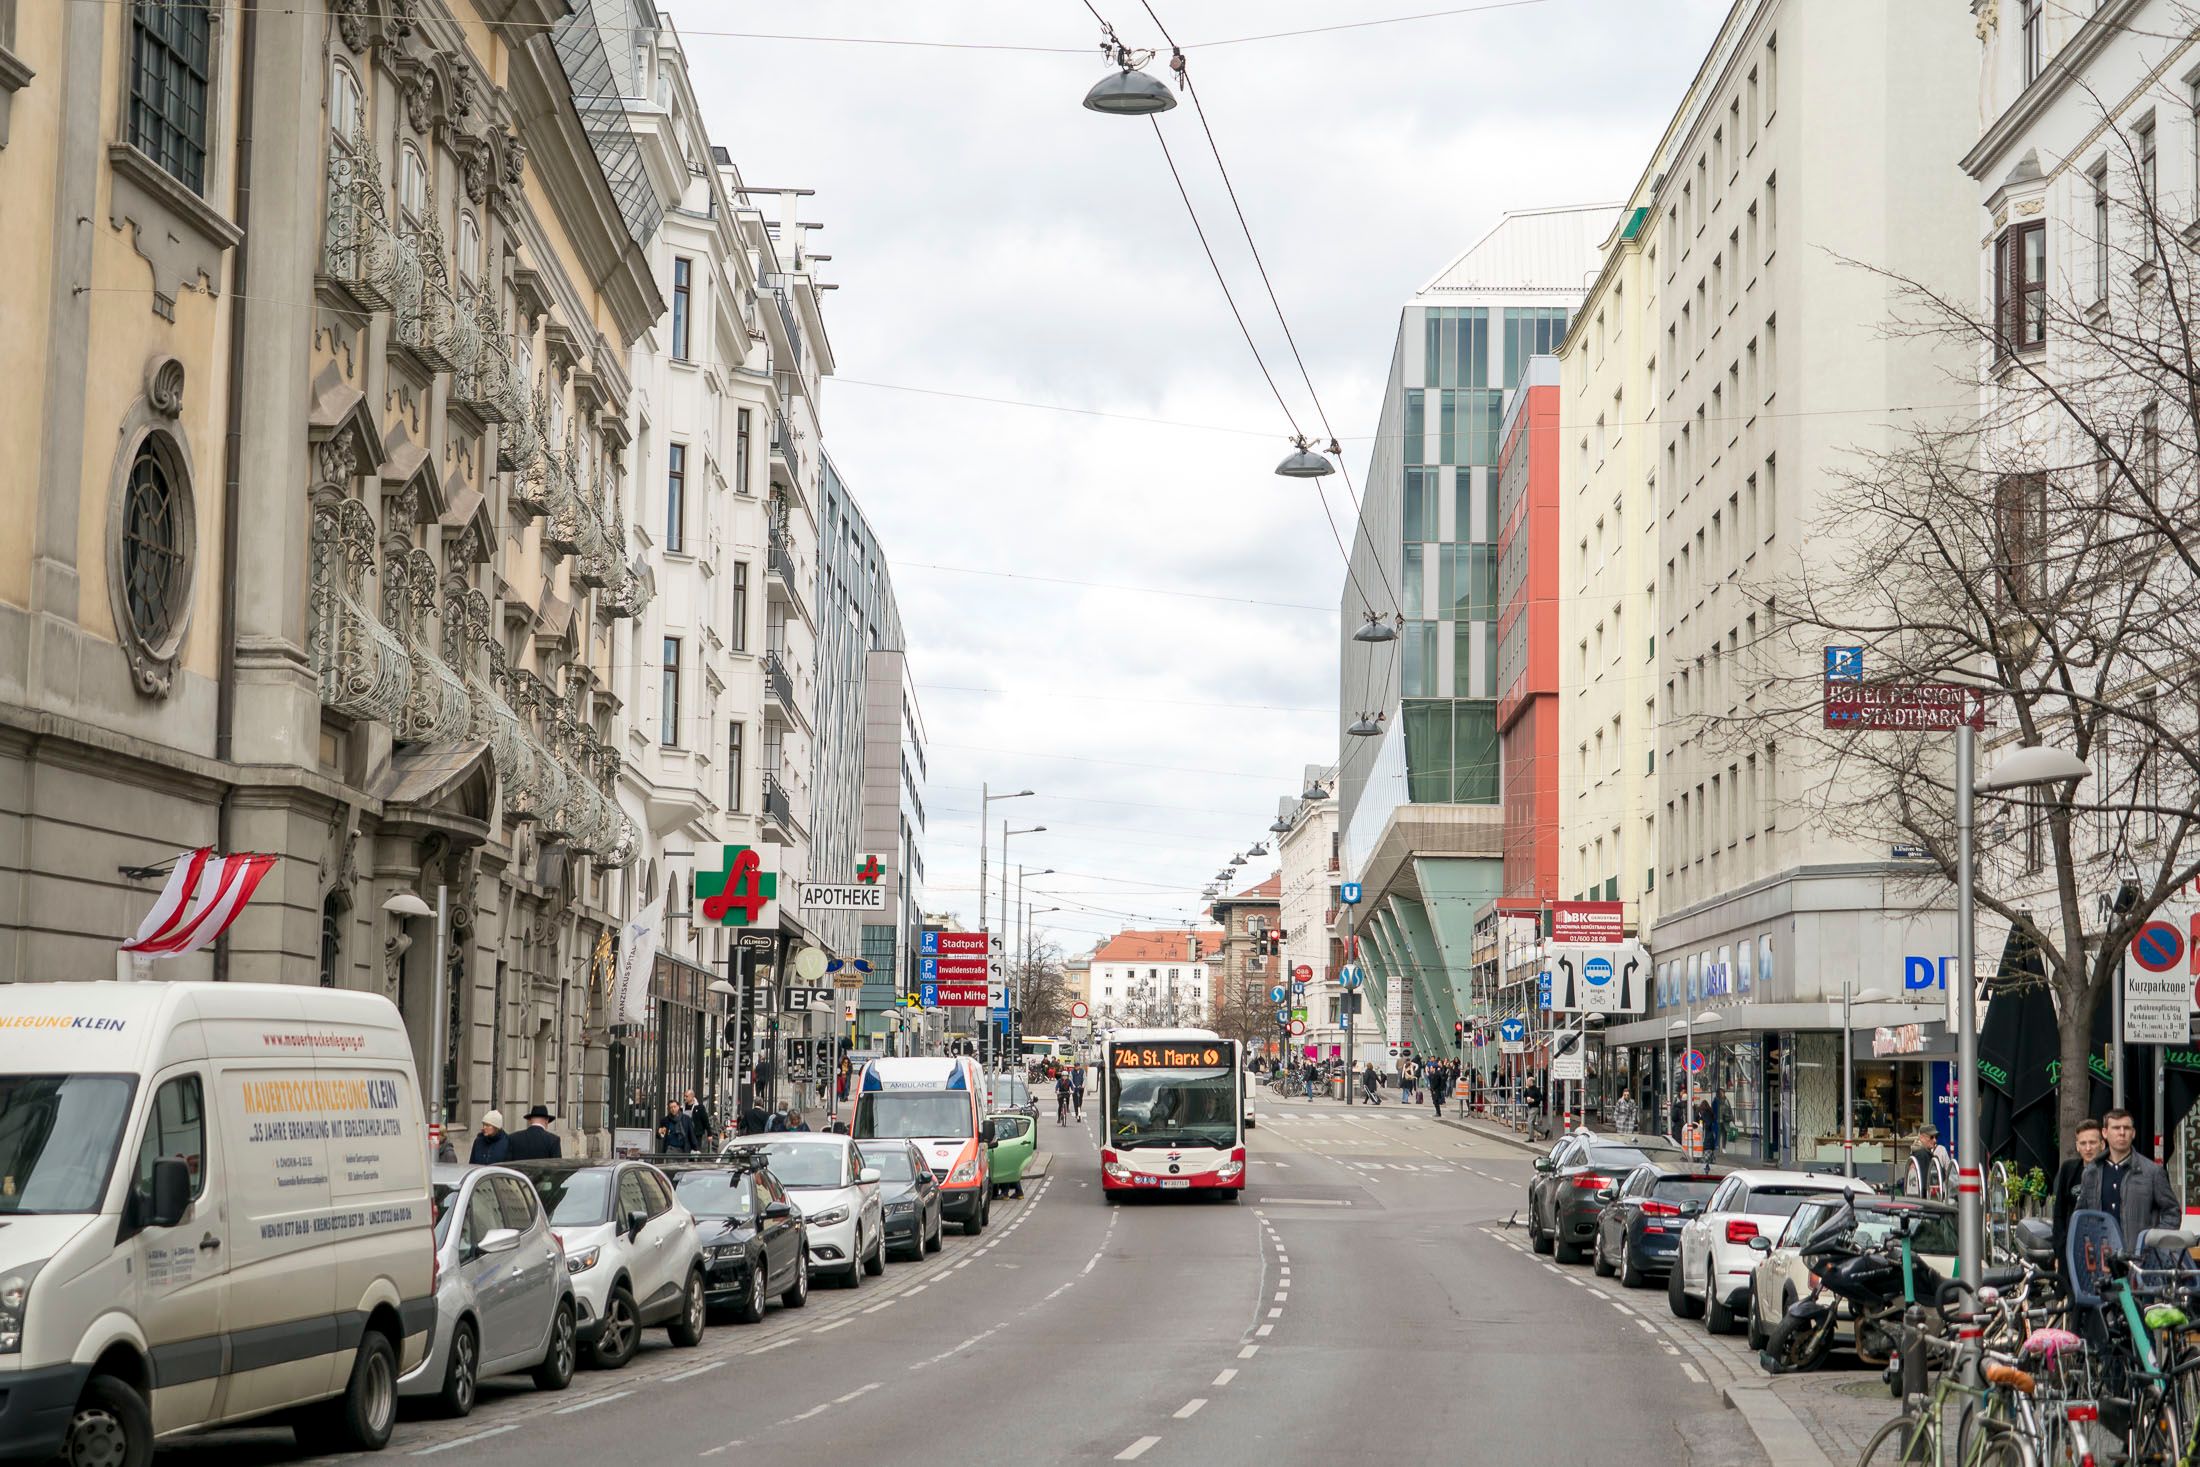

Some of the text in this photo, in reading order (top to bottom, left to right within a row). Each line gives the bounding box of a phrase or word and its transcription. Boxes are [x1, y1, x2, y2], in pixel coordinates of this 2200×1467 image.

[1829, 686, 1962, 705] HOTEL PENSION
[1861, 707, 1963, 727] STADTPARK
[804, 887, 880, 906] APOTHEKE
[1344, 886, 1358, 900] U
[942, 939, 985, 950] Stadtpark
[938, 966, 986, 974] Invalidenstraße
[618, 945, 637, 1022] FRANZISKUS SPITAL
[2129, 978, 2186, 995] Kurzparkzone
[938, 990, 987, 1000] Wien Mitte
[2130, 1012, 2159, 1020] Parkdauer:
[2172, 1013, 2184, 1021] Std.
[2133, 1004, 2181, 1013] gebührenpflichtig
[262, 1032, 365, 1052] www.mauertrockenlegung.at
[1115, 1049, 1200, 1066] 74A St. Marx
[265, 1120, 287, 1142] JAHRE
[289, 1119, 330, 1141] ERFAHRUNG
[331, 1120, 343, 1138] MIT
[344, 1118, 401, 1138] EDELSTAHLPLATTEN
